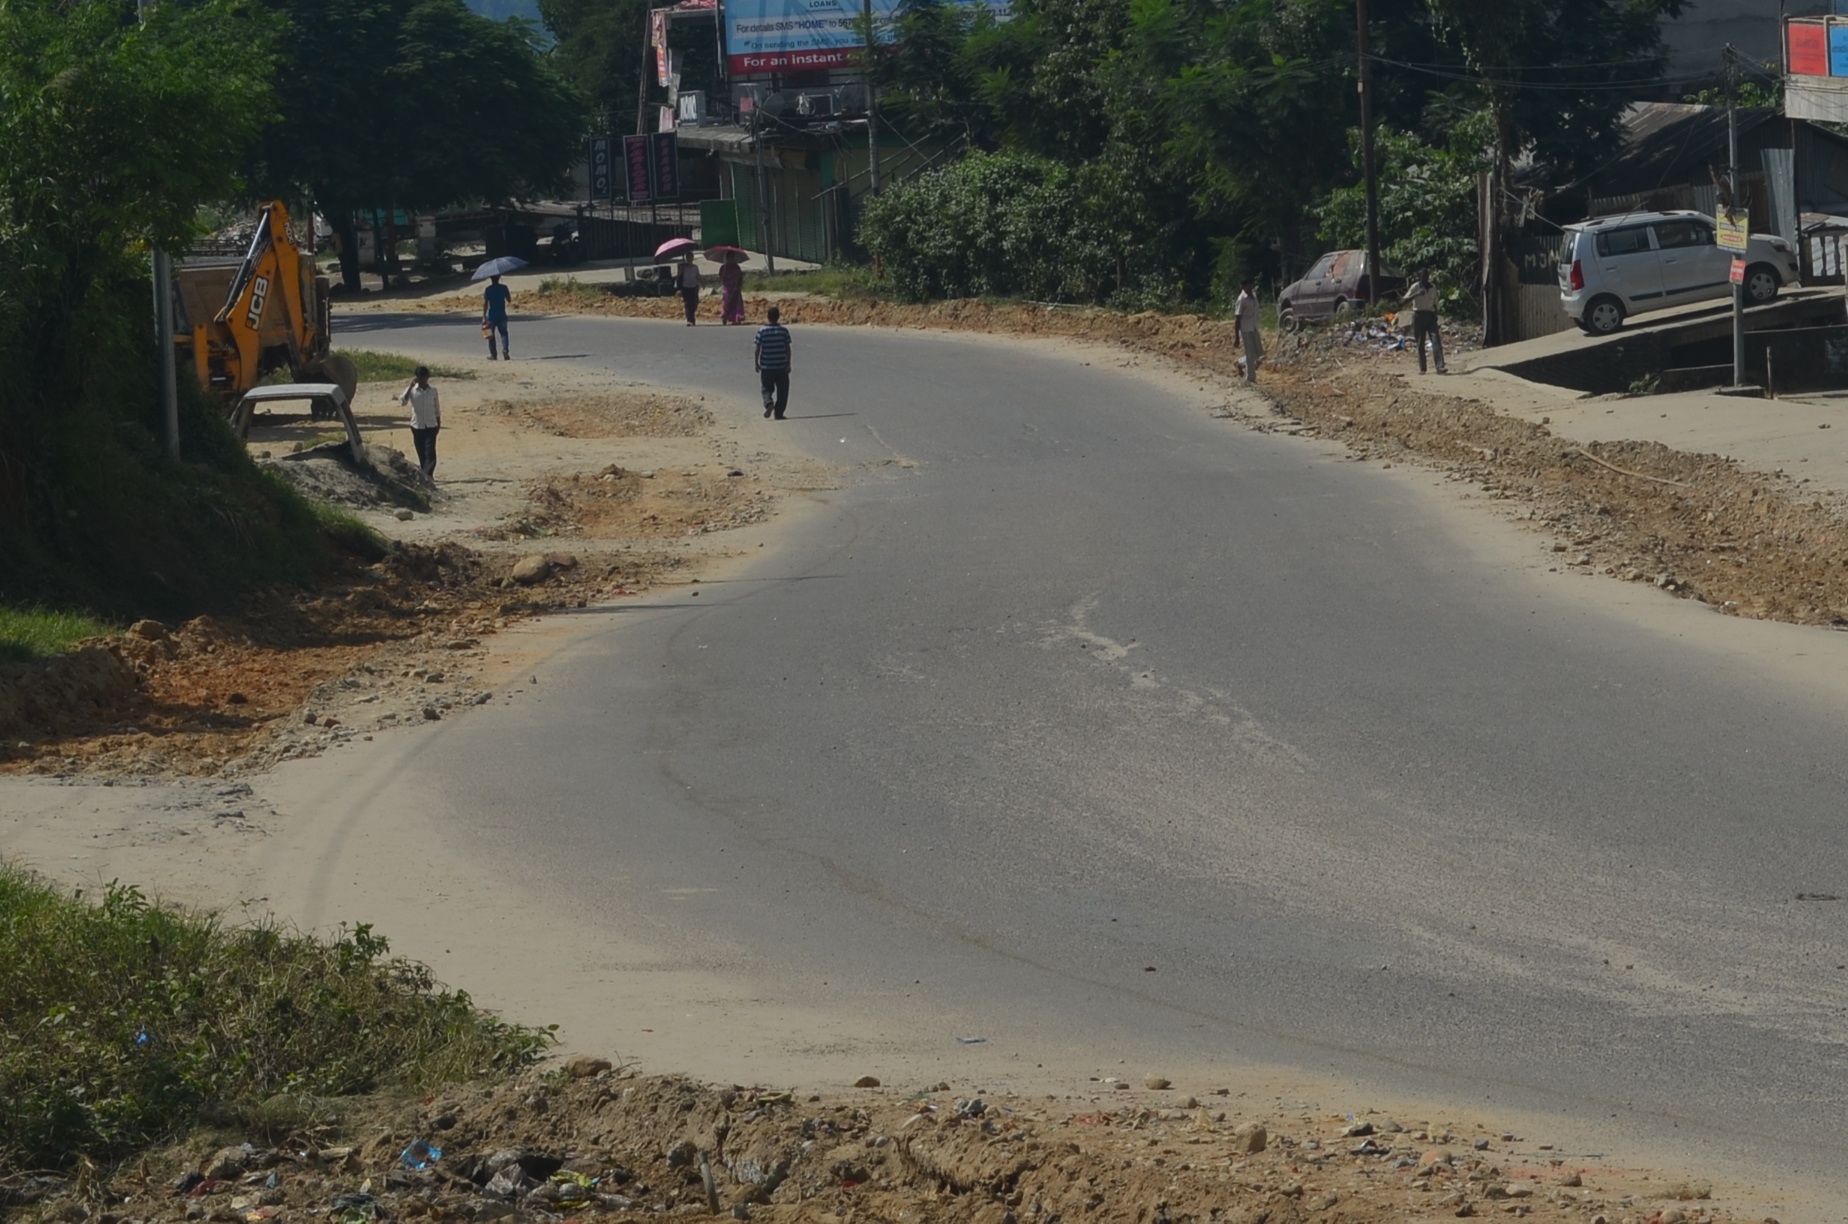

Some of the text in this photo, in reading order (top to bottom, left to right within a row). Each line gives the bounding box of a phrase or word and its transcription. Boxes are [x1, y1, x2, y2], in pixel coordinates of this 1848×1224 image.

[809, 0, 838, 8] LOANS
[736, 24, 748, 34] For
[751, 22, 774, 33] details
[776, 21, 793, 31] SMS
[829, 19, 837, 27] to
[764, 39, 795, 51] sending
[797, 39, 809, 47] the
[744, 56, 768, 68] For
[770, 57, 787, 66] an
[792, 53, 843, 65] instant
[248, 276, 268, 330] JCB
